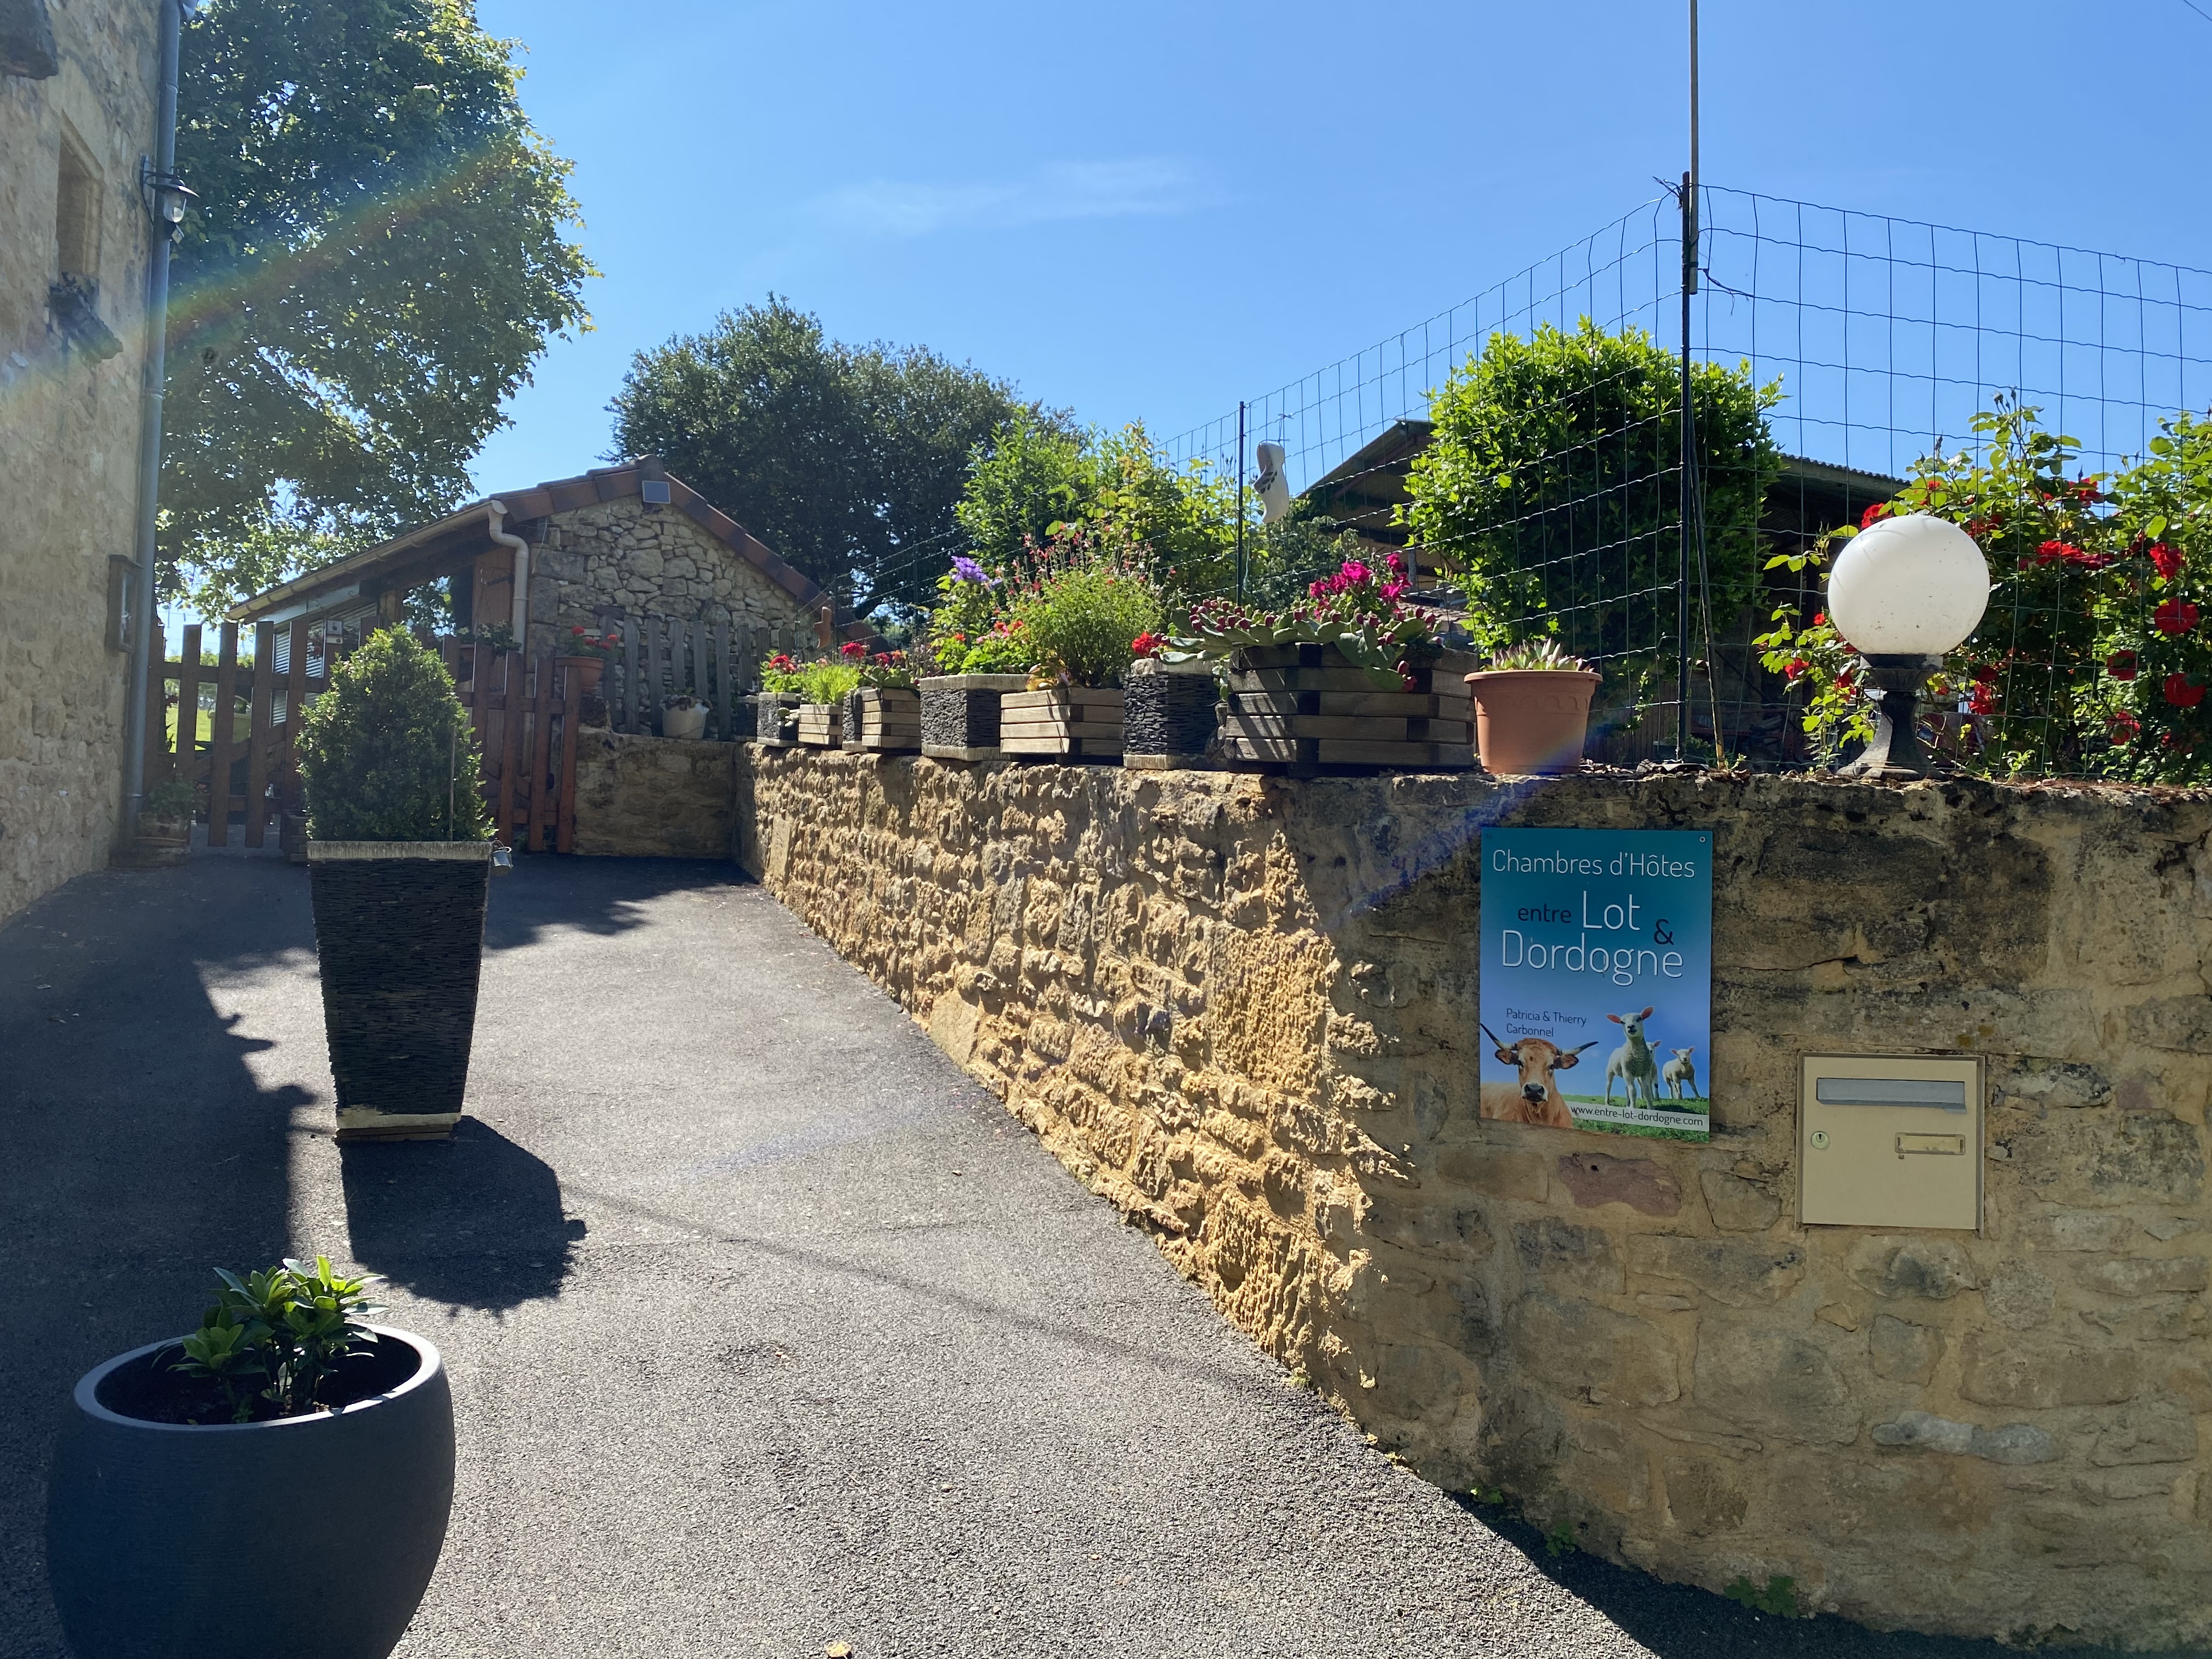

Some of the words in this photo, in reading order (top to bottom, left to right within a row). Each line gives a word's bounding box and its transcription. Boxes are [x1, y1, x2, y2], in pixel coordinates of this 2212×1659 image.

[1493, 849, 1602, 875] Chambres
[1610, 851, 1695, 878] d'Hôtes
[1517, 904, 1572, 923] entre
[1583, 890, 1640, 930] Lot
[1653, 918, 1674, 945] &
[1502, 929, 1683, 986] Dordogne
[1506, 1008, 1540, 1021] Patricia
[1543, 1011, 1550, 1022] &
[1553, 1012, 1587, 1027] Thierry
[1506, 1023, 1554, 1037] Carbonnel
[1571, 1105, 1703, 1126] www.entre-lot-dordogne.com
